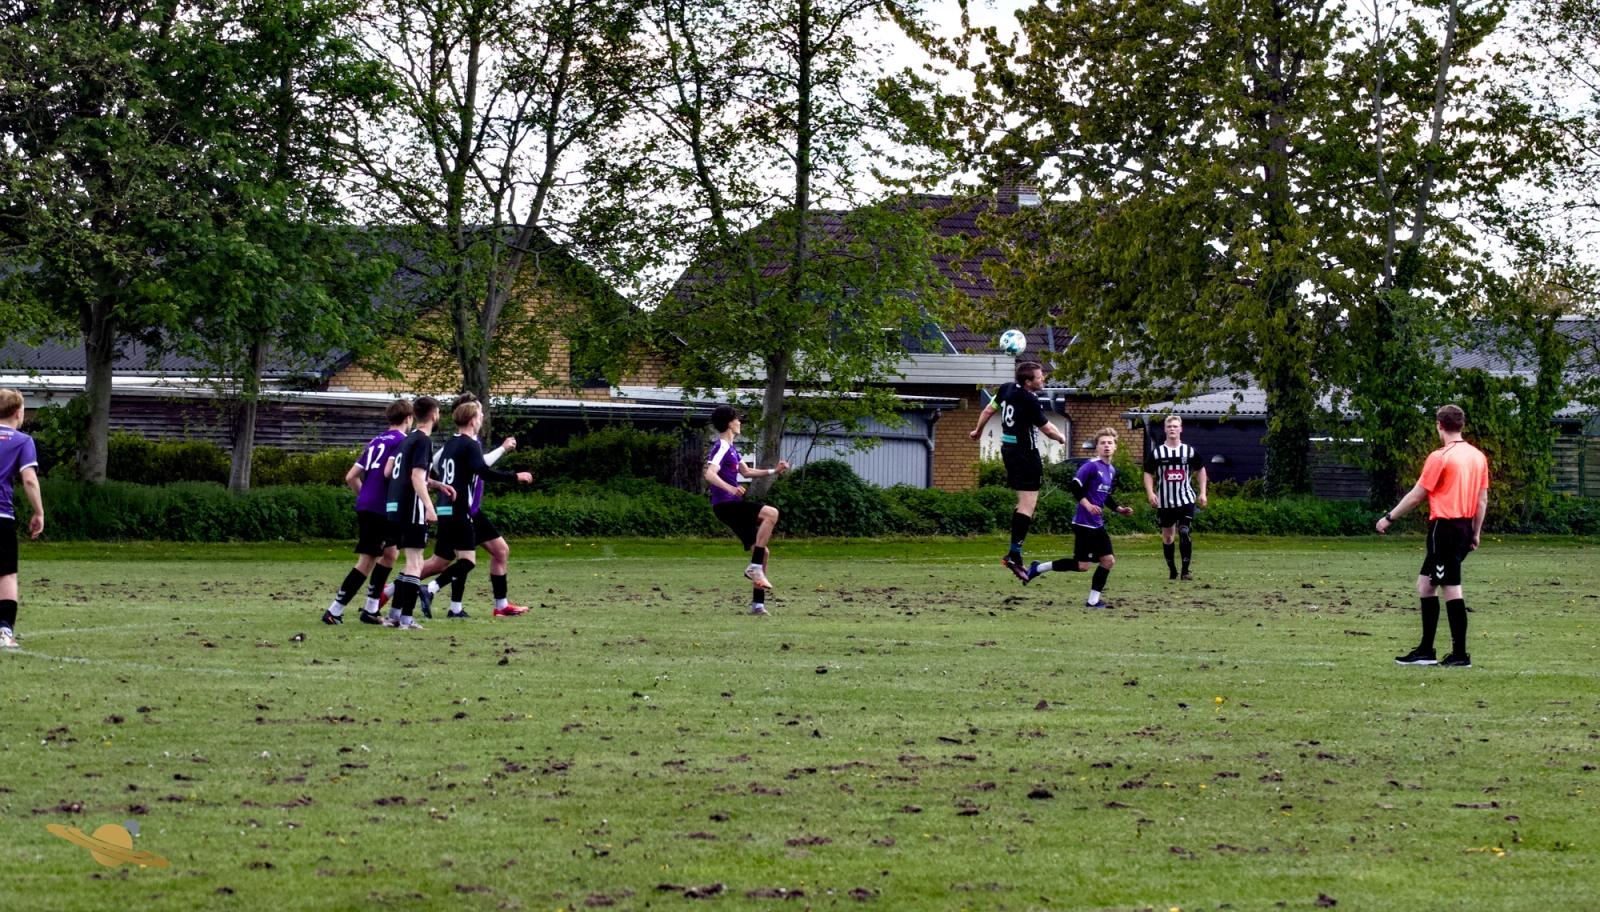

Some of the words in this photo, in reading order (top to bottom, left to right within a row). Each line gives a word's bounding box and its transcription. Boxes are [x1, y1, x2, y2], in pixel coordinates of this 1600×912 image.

[1000, 400, 1015, 427] 18
[365, 443, 385, 471] 12
[392, 452, 403, 480] 8
[441, 458, 455, 484] 19
